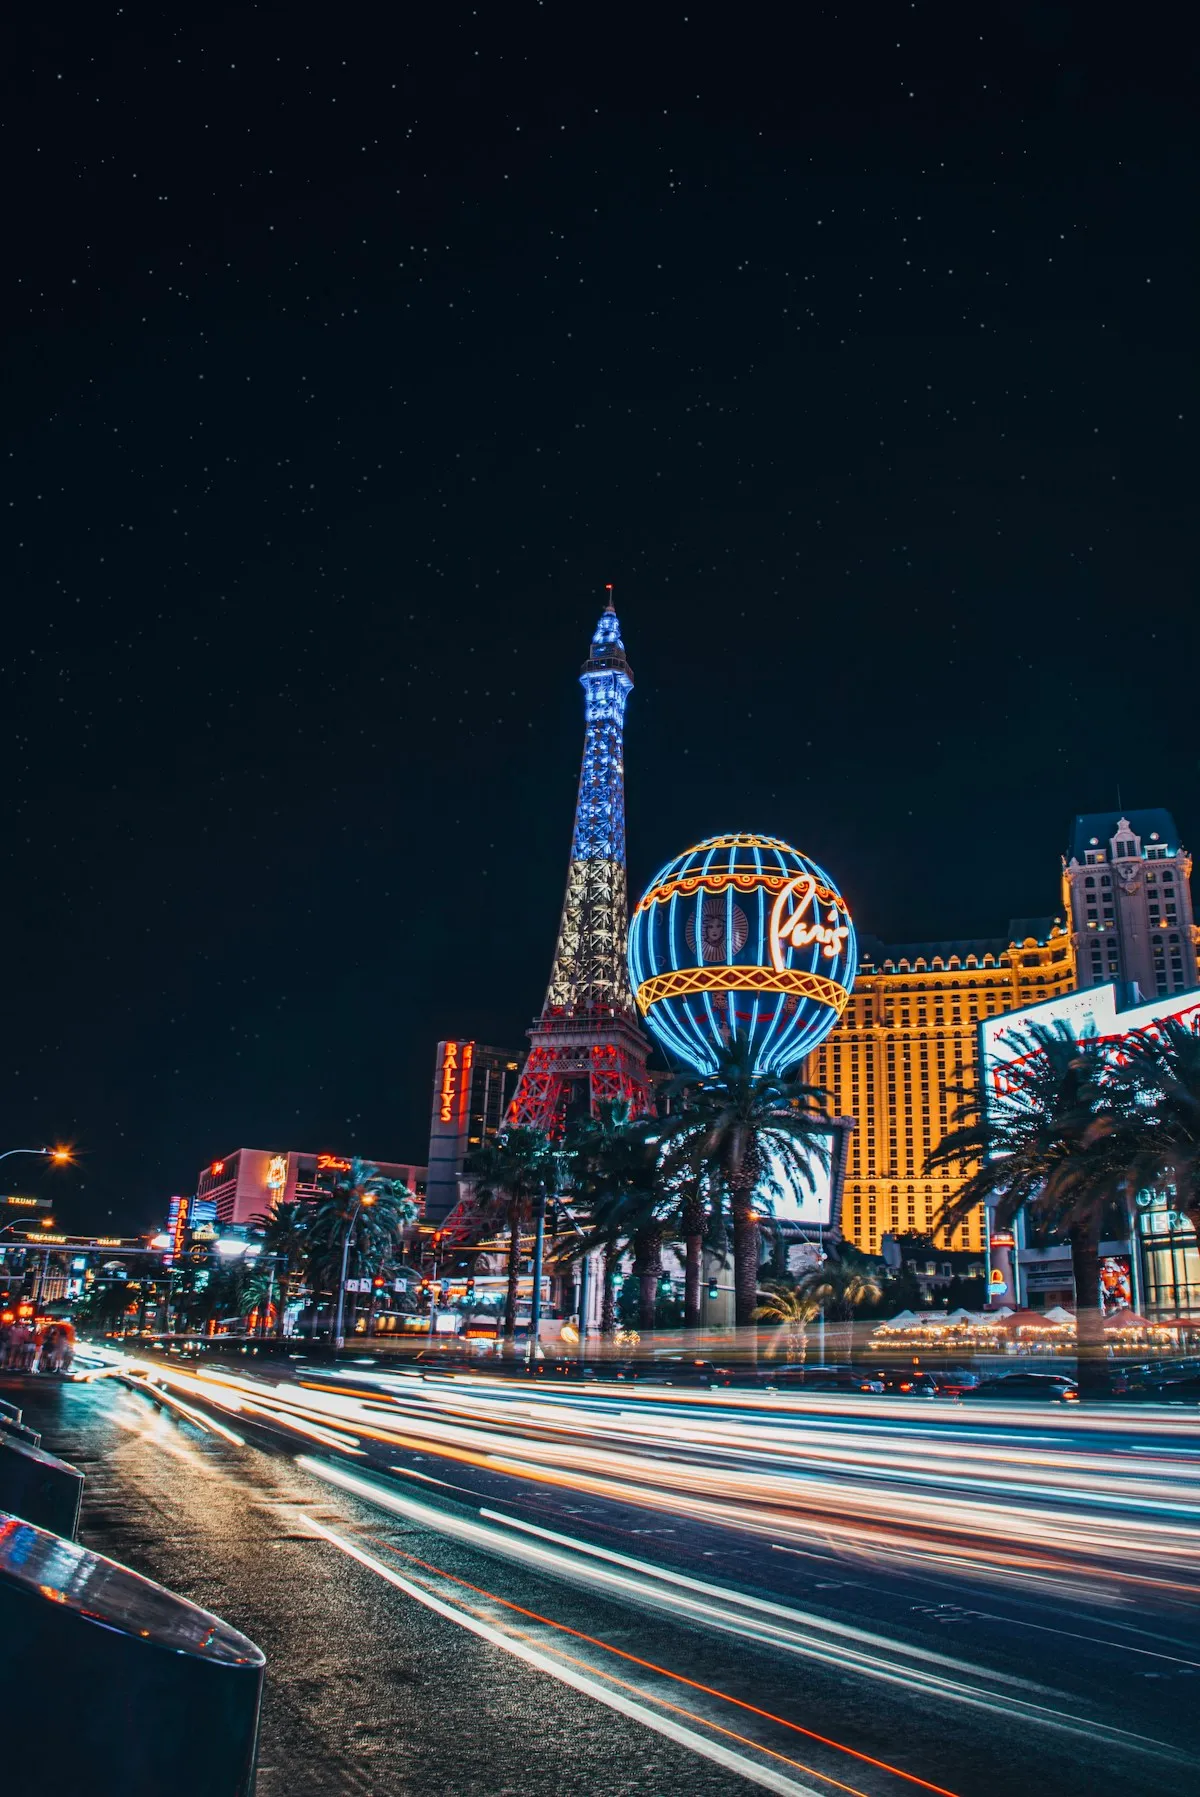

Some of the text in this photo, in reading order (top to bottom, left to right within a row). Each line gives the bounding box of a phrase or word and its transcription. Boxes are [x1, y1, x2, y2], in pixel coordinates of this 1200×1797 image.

[771, 874, 850, 973] Paris
[8, 1196, 37, 1206] TRUMP
[27, 1233, 121, 1246] TREASURE ISLAND
